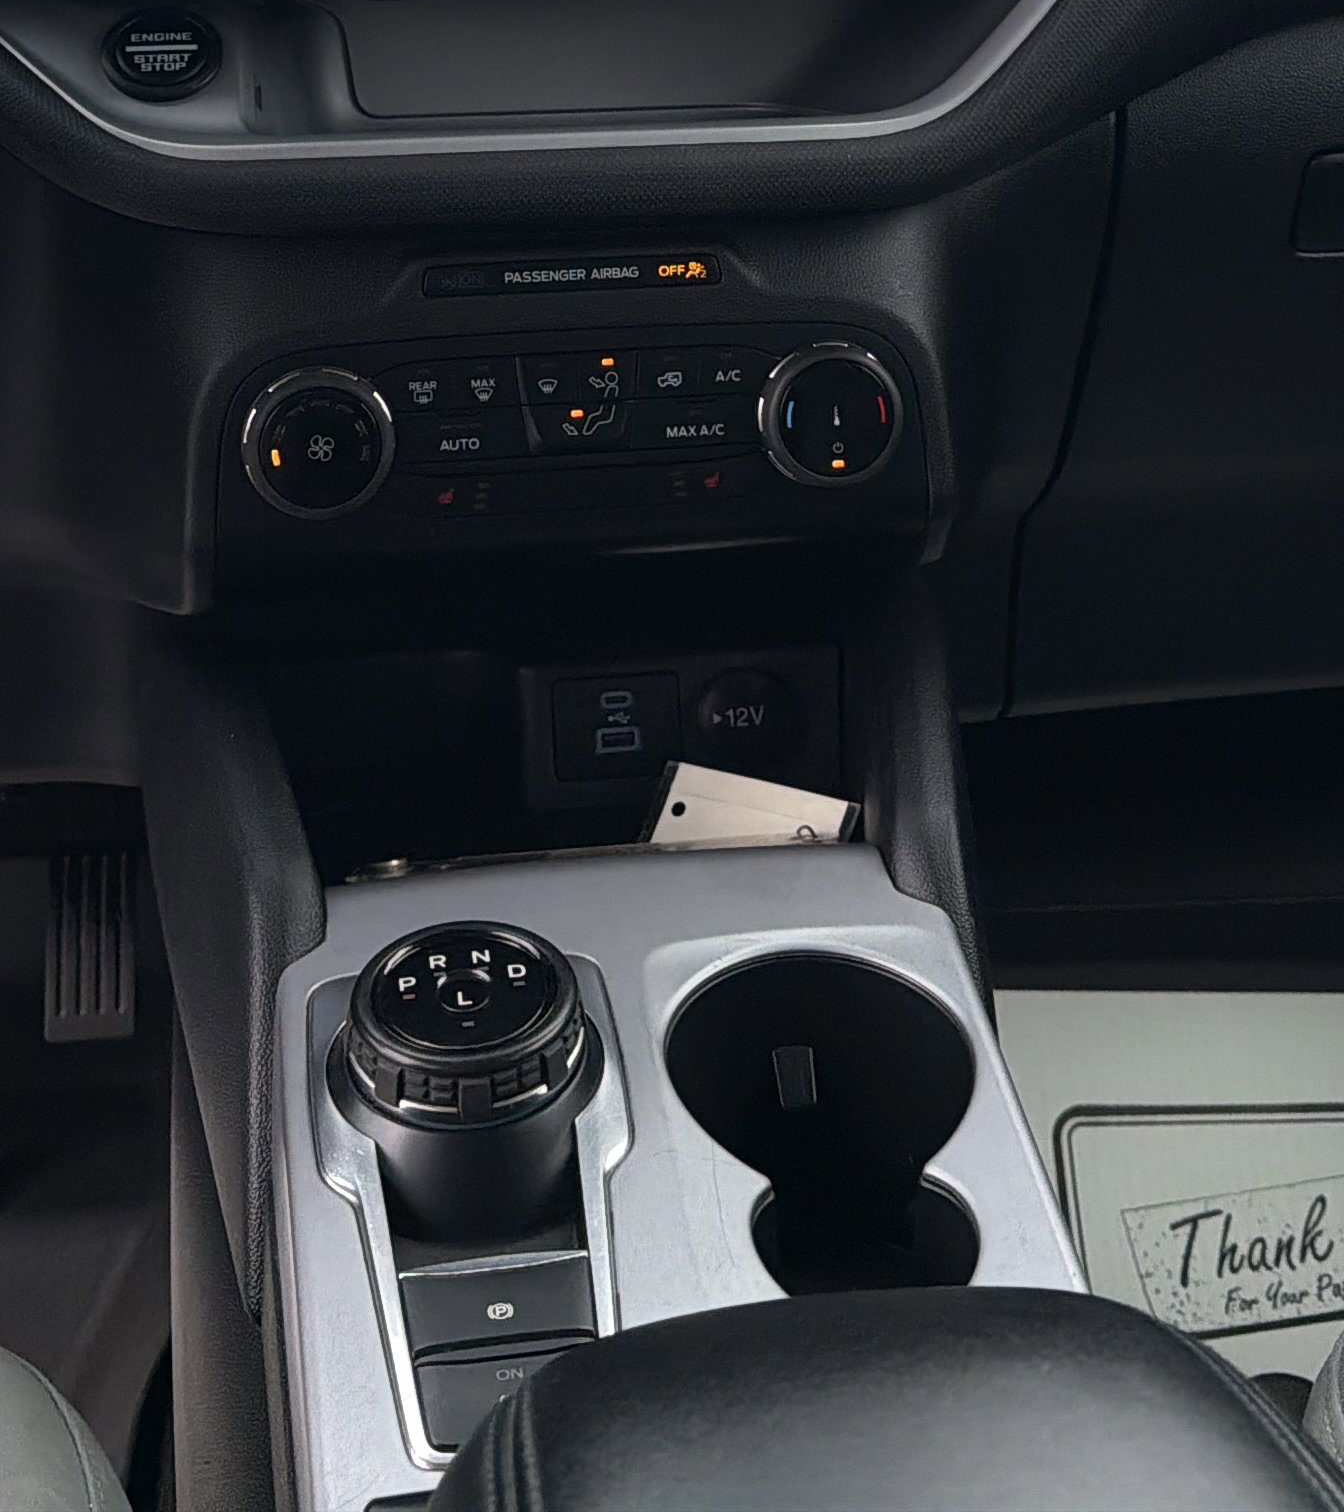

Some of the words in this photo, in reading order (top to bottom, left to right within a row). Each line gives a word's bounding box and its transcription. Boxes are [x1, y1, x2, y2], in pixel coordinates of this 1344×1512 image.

[130, 31, 192, 43] ENGINE
[133, 52, 192, 64] START
[140, 61, 187, 72] STOP
[504, 269, 586, 284] PASSENGER
[590, 266, 639, 280] AIRBAG
[658, 264, 685, 278] OFF
[714, 367, 742, 383] A/C
[408, 380, 438, 392] REAR
[470, 378, 497, 390] MAX
[665, 423, 696, 438] MAX
[698, 423, 725, 438] A/C
[439, 436, 481, 451] AUTO
[724, 705, 766, 727] 12V
[428, 954, 448, 970] R
[471, 949, 491, 965] N
[507, 964, 527, 978] D
[398, 976, 417, 992] P
[456, 991, 474, 1006] L
[1169, 1194, 1335, 1288] Thank
[1224, 1286, 1260, 1315] For
[1264, 1279, 1310, 1310] Your
[495, 1367, 524, 1381] ON
